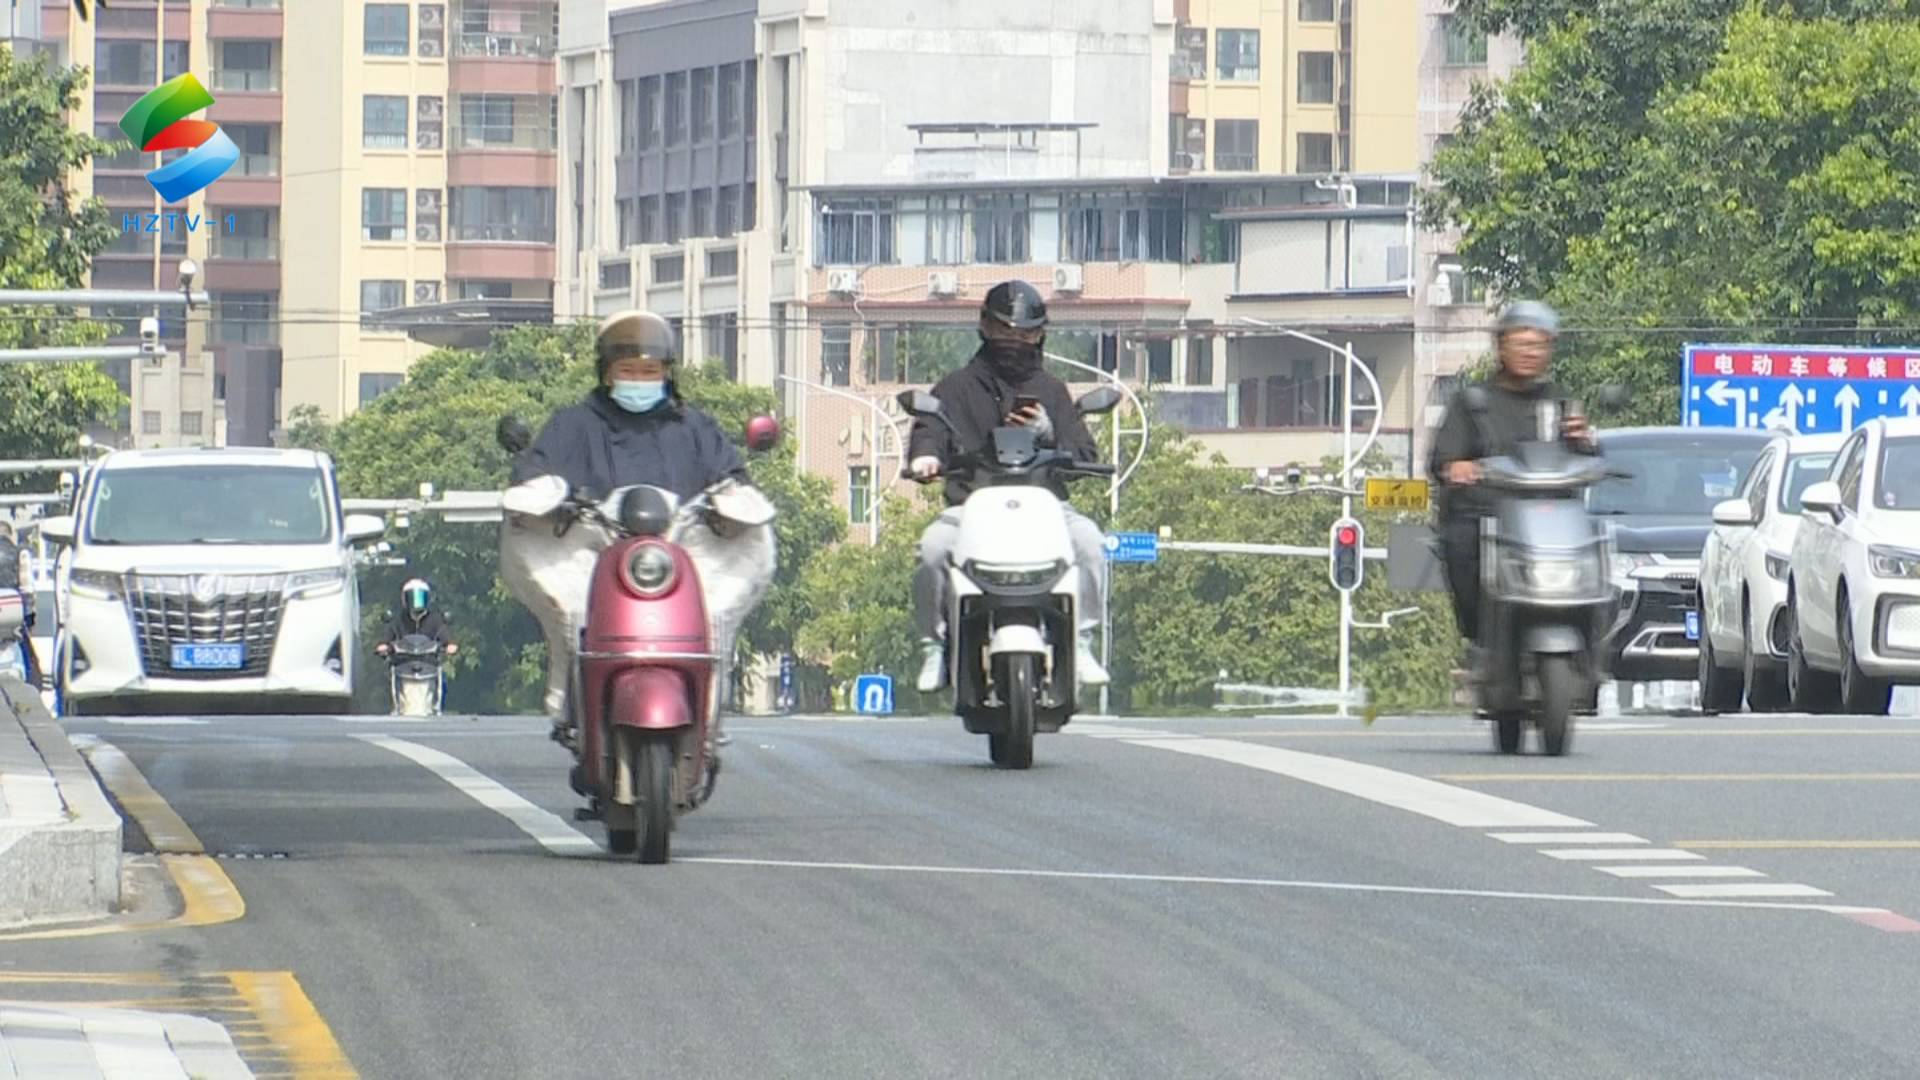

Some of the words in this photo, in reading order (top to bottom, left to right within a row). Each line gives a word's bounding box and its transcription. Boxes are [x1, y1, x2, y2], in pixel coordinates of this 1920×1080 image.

[1714, 354, 1920, 378] 电动车等候区
